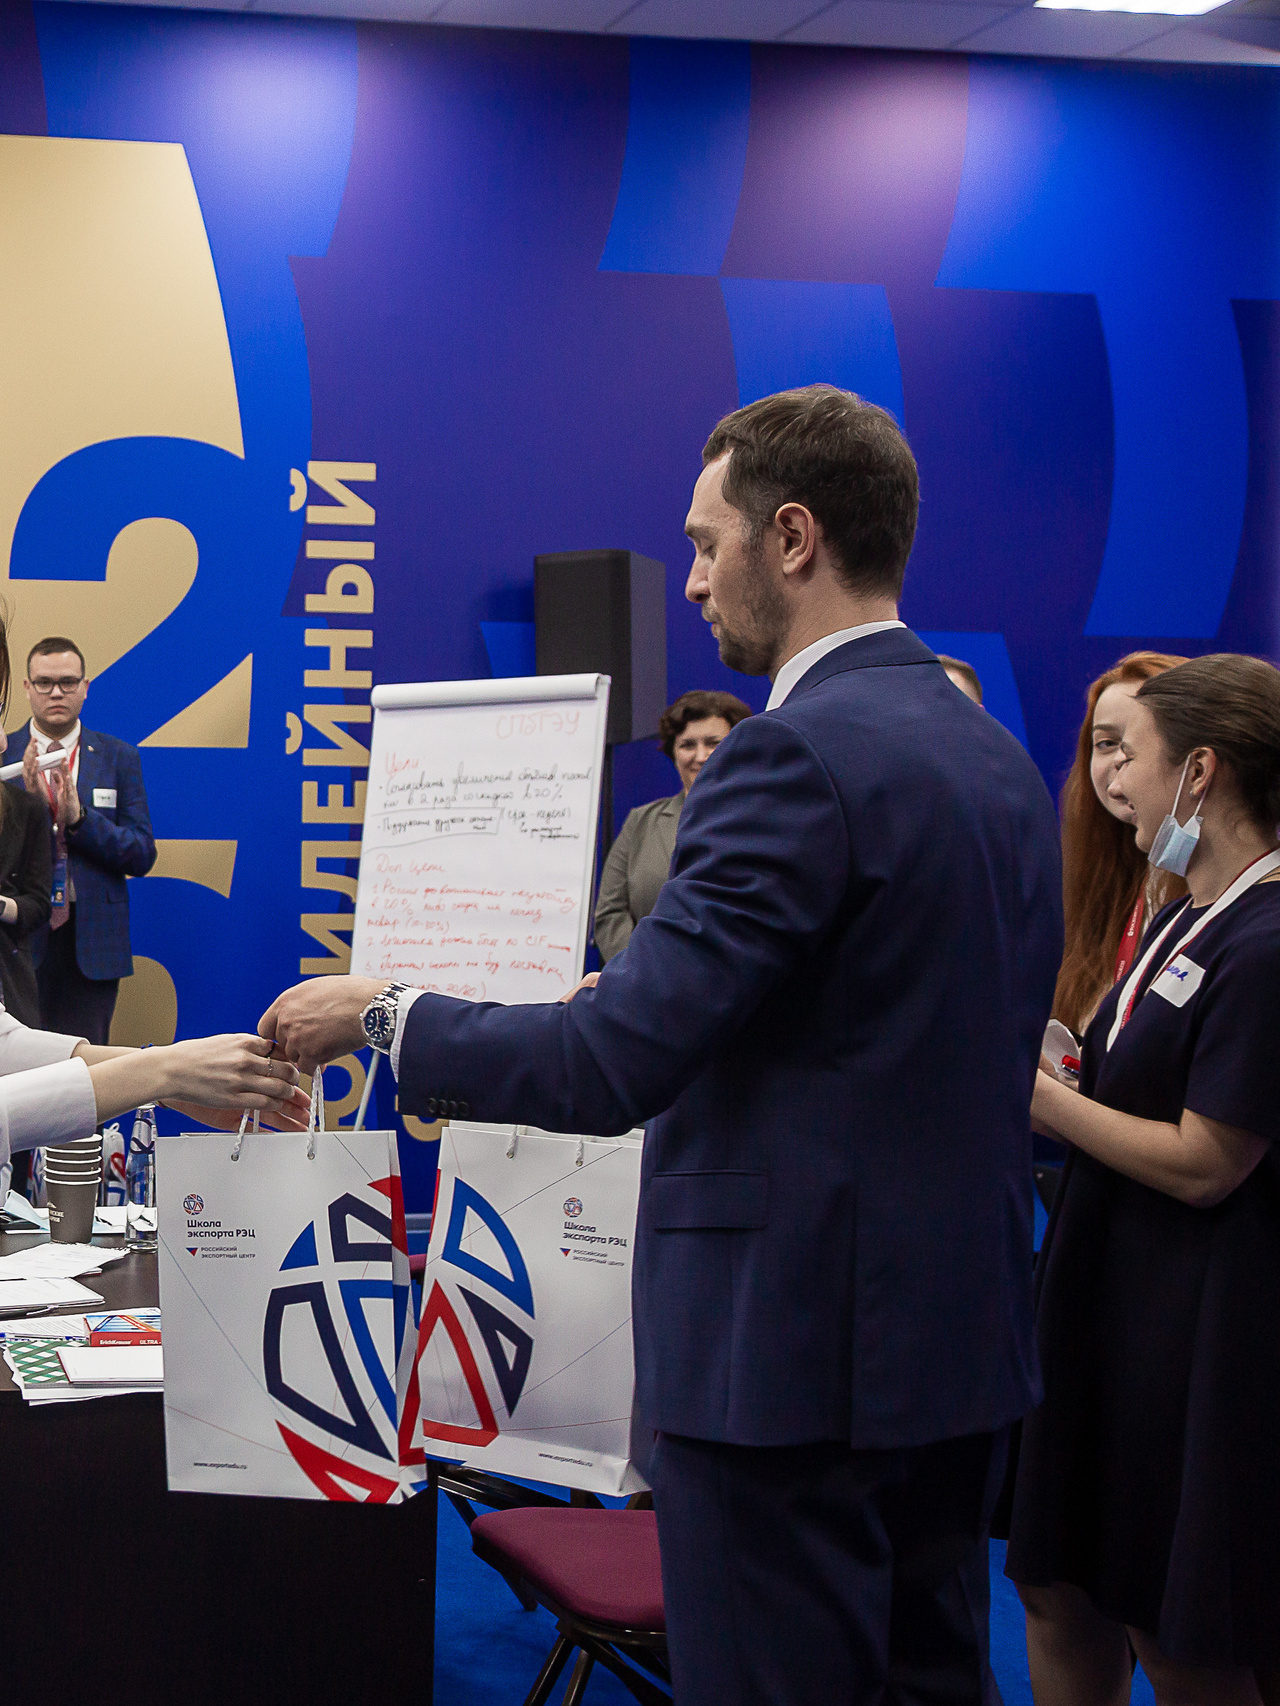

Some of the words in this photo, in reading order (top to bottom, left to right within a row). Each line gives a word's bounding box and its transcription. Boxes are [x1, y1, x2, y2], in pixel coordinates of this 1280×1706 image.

[187, 1220, 222, 1228] Школа
[564, 1221, 597, 1233] Школа
[187, 1230, 234, 1239] экспорта
[236, 1229, 256, 1238] РЭЦ
[562, 1232, 607, 1244] экспорта
[608, 1236, 628, 1248] РЭЦ
